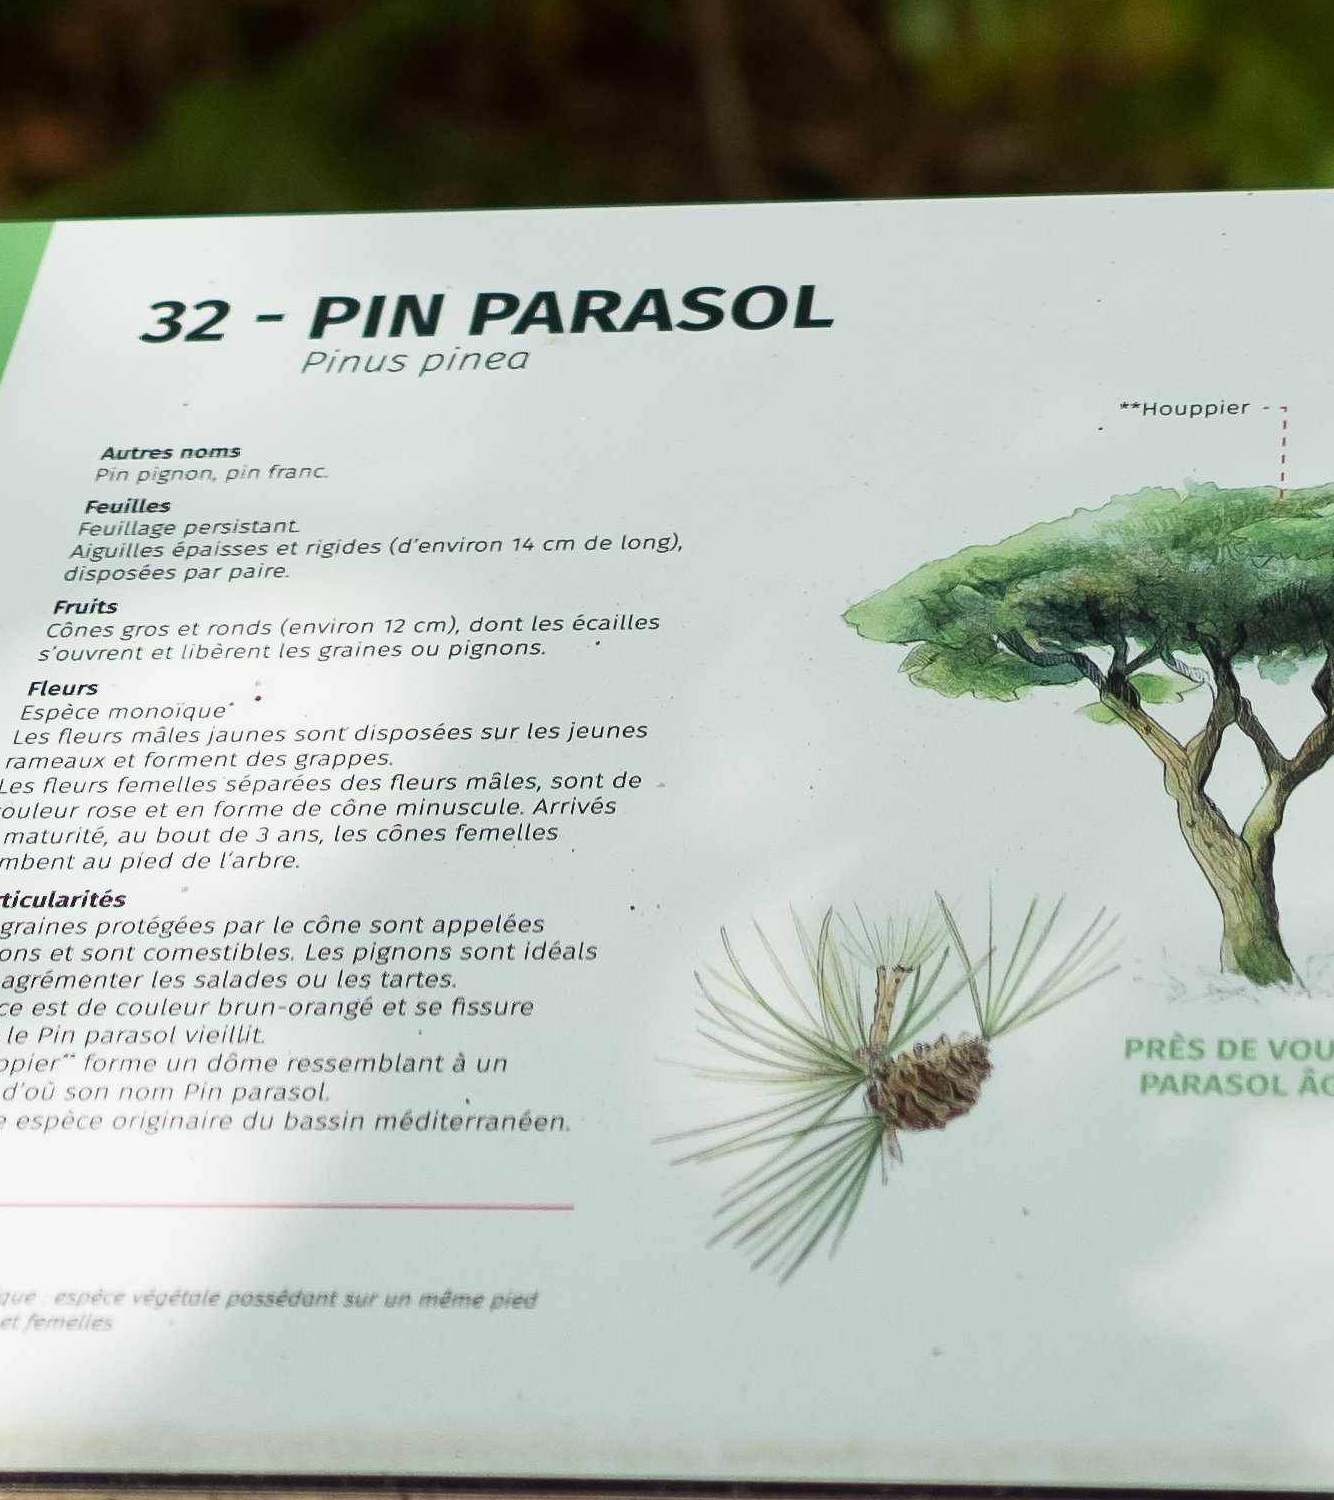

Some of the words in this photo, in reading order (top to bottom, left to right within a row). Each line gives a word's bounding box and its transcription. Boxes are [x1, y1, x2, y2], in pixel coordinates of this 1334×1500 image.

[139, 299, 231, 344] 32
[255, 313, 285, 323] -
[309, 293, 445, 340] PIN
[468, 284, 835, 336] PARASOL
[300, 349, 409, 374] Pinus
[418, 346, 531, 378] pinea
[100, 446, 174, 461] Autres
[179, 446, 241, 459] noms
[94, 467, 130, 482] Pin
[135, 468, 217, 486] pignon,
[224, 467, 261, 483] pin
[268, 463, 328, 480] franc.
[84, 497, 171, 515] Feuilles
[77, 520, 177, 540] Feuillage
[69, 542, 165, 563] Aiguilles
[171, 540, 269, 561] épaisses
[276, 541, 298, 556] et
[305, 538, 382, 559] rigides
[512, 537, 535, 552] 14
[542, 538, 576, 552] cm
[583, 535, 613, 551] de
[620, 532, 683, 554] long),
[63, 563, 177, 585] disposées
[183, 566, 223, 583] par
[227, 562, 290, 583] paire.
[53, 597, 118, 615] Fruits
[46, 621, 115, 639] Cônes
[119, 624, 170, 642] gros
[177, 622, 200, 637] et
[207, 619, 272, 637] ronds
[280, 617, 375, 637] (environ
[384, 618, 406, 634] 12
[413, 614, 460, 635] cm),
[469, 616, 523, 633] dont
[531, 615, 564, 632] les
[572, 613, 660, 632] écailles
[150, 645, 174, 661] et
[180, 642, 271, 660] libèrent
[278, 642, 311, 659] les
[316, 644, 403, 663] graines
[410, 644, 440, 657] ou
[447, 639, 546, 661] pignons.
[27, 679, 99, 697] Fleurs
[20, 702, 100, 724] Espèce
[5, 756, 106, 770] rameaux
[113, 753, 135, 769] et
[143, 751, 237, 768] forment
[245, 750, 287, 768] des
[293, 752, 393, 771] grappes.
[86, 805, 137, 819] rose
[144, 802, 169, 819] et
[175, 804, 205, 818] en
[213, 800, 284, 818] forme
[291, 799, 322, 818] de
[329, 798, 387, 817] cône
[395, 797, 524, 817] minuscule.
[532, 795, 617, 815] Arrivés
[3, 825, 108, 847] maturité,
[117, 830, 147, 844] au
[155, 826, 211, 844] bout
[218, 826, 249, 844] de
[255, 826, 270, 843] 3
[276, 829, 324, 845] ans,
[333, 824, 368, 843] les
[376, 823, 447, 843] cônes
[455, 822, 559, 842] femelles
[81, 856, 112, 870] au
[119, 851, 174, 874] pied
[181, 851, 211, 870] de
[94, 915, 216, 940] protégées
[222, 920, 266, 939] par
[273, 915, 295, 935] le
[302, 914, 362, 935] cône
[369, 916, 424, 934] sont
[431, 913, 545, 938] appelées
[49, 945, 74, 962] et
[80, 945, 135, 962] sont
[143, 942, 294, 962] comestibles.
[305, 942, 344, 962] Les
[352, 941, 452, 966] pignons
[459, 943, 516, 961] sont
[524, 940, 598, 961] idéals
[1, 969, 144, 994] agrémenter
[151, 970, 186, 989] les
[193, 969, 288, 989] salades
[296, 973, 328, 989] ou
[336, 968, 372, 989] les
[381, 970, 456, 989] tartes.
[31, 1000, 68, 1017] est
[76, 997, 107, 1017] de
[115, 997, 210, 1017] couleur
[217, 996, 374, 1021] brun-orangé
[382, 998, 407, 1017] et
[414, 1001, 443, 1017] se
[451, 996, 534, 1017] fissure
[6, 1025, 29, 1045] le
[37, 1026, 76, 1044] Pin
[83, 1025, 177, 1049] parasol
[185, 1024, 265, 1044] vieillit.
[1124, 1035, 1206, 1060] PRÈS
[1216, 1037, 1257, 1061] DE
[1139, 1072, 1288, 1097] PARASOL
